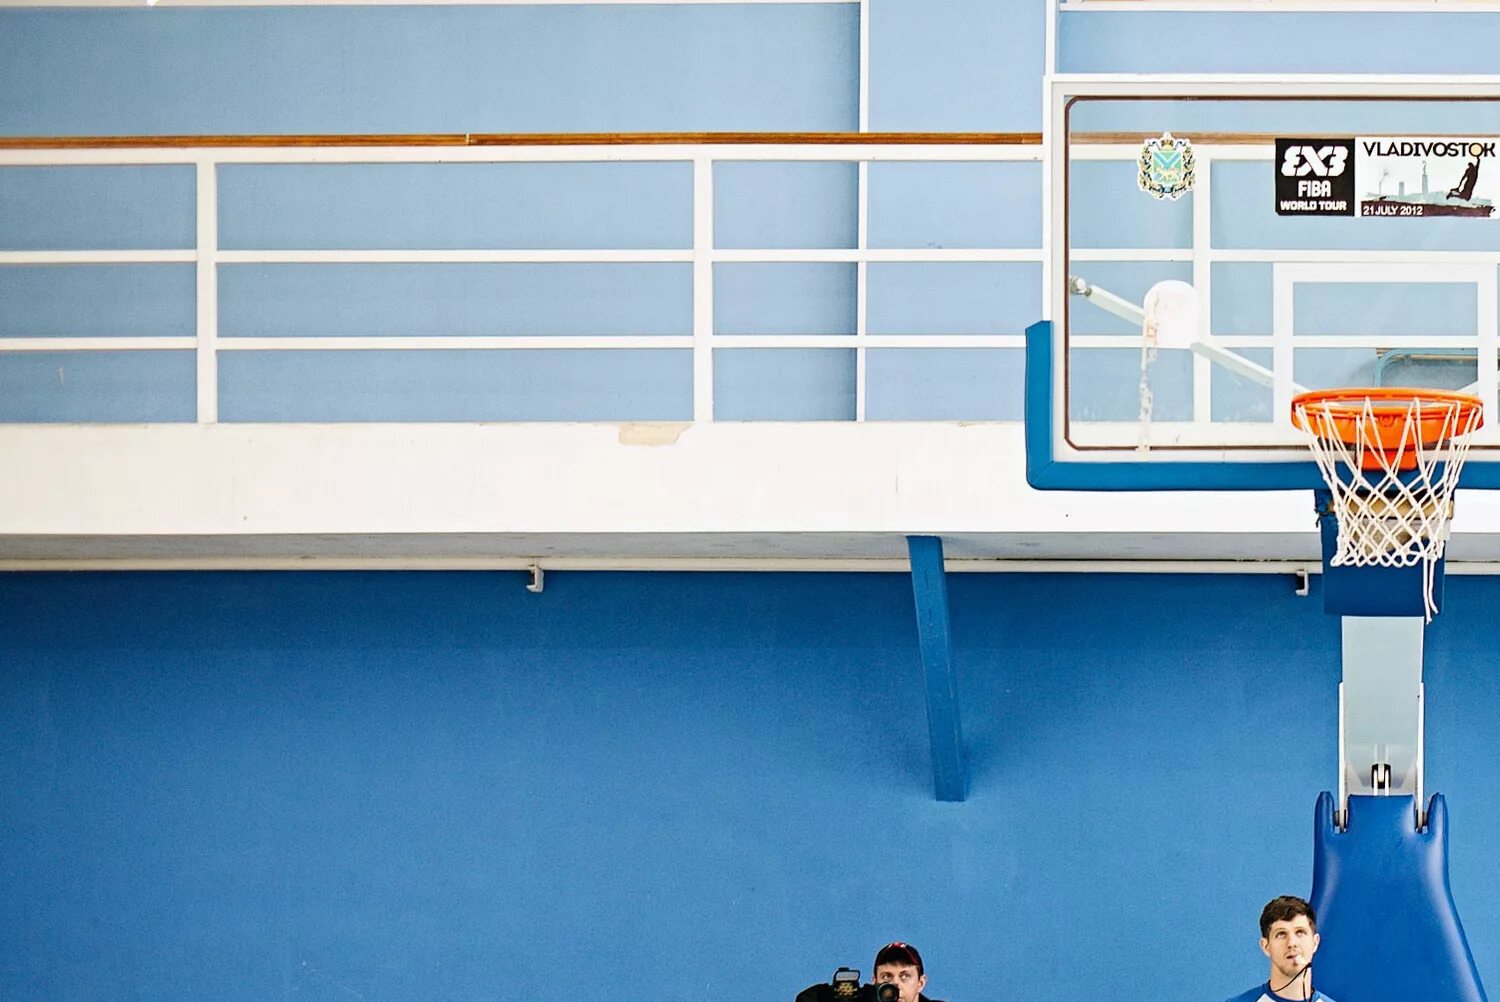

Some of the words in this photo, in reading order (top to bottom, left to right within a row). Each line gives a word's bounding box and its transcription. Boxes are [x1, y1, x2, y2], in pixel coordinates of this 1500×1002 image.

[1362, 141, 1496, 157] VLADIVOSTOK
[1298, 180, 1332, 198] FIBA
[1280, 200, 1318, 211] WORLD
[1318, 200, 1347, 211] TOUR
[1399, 205, 1424, 216] 2012
